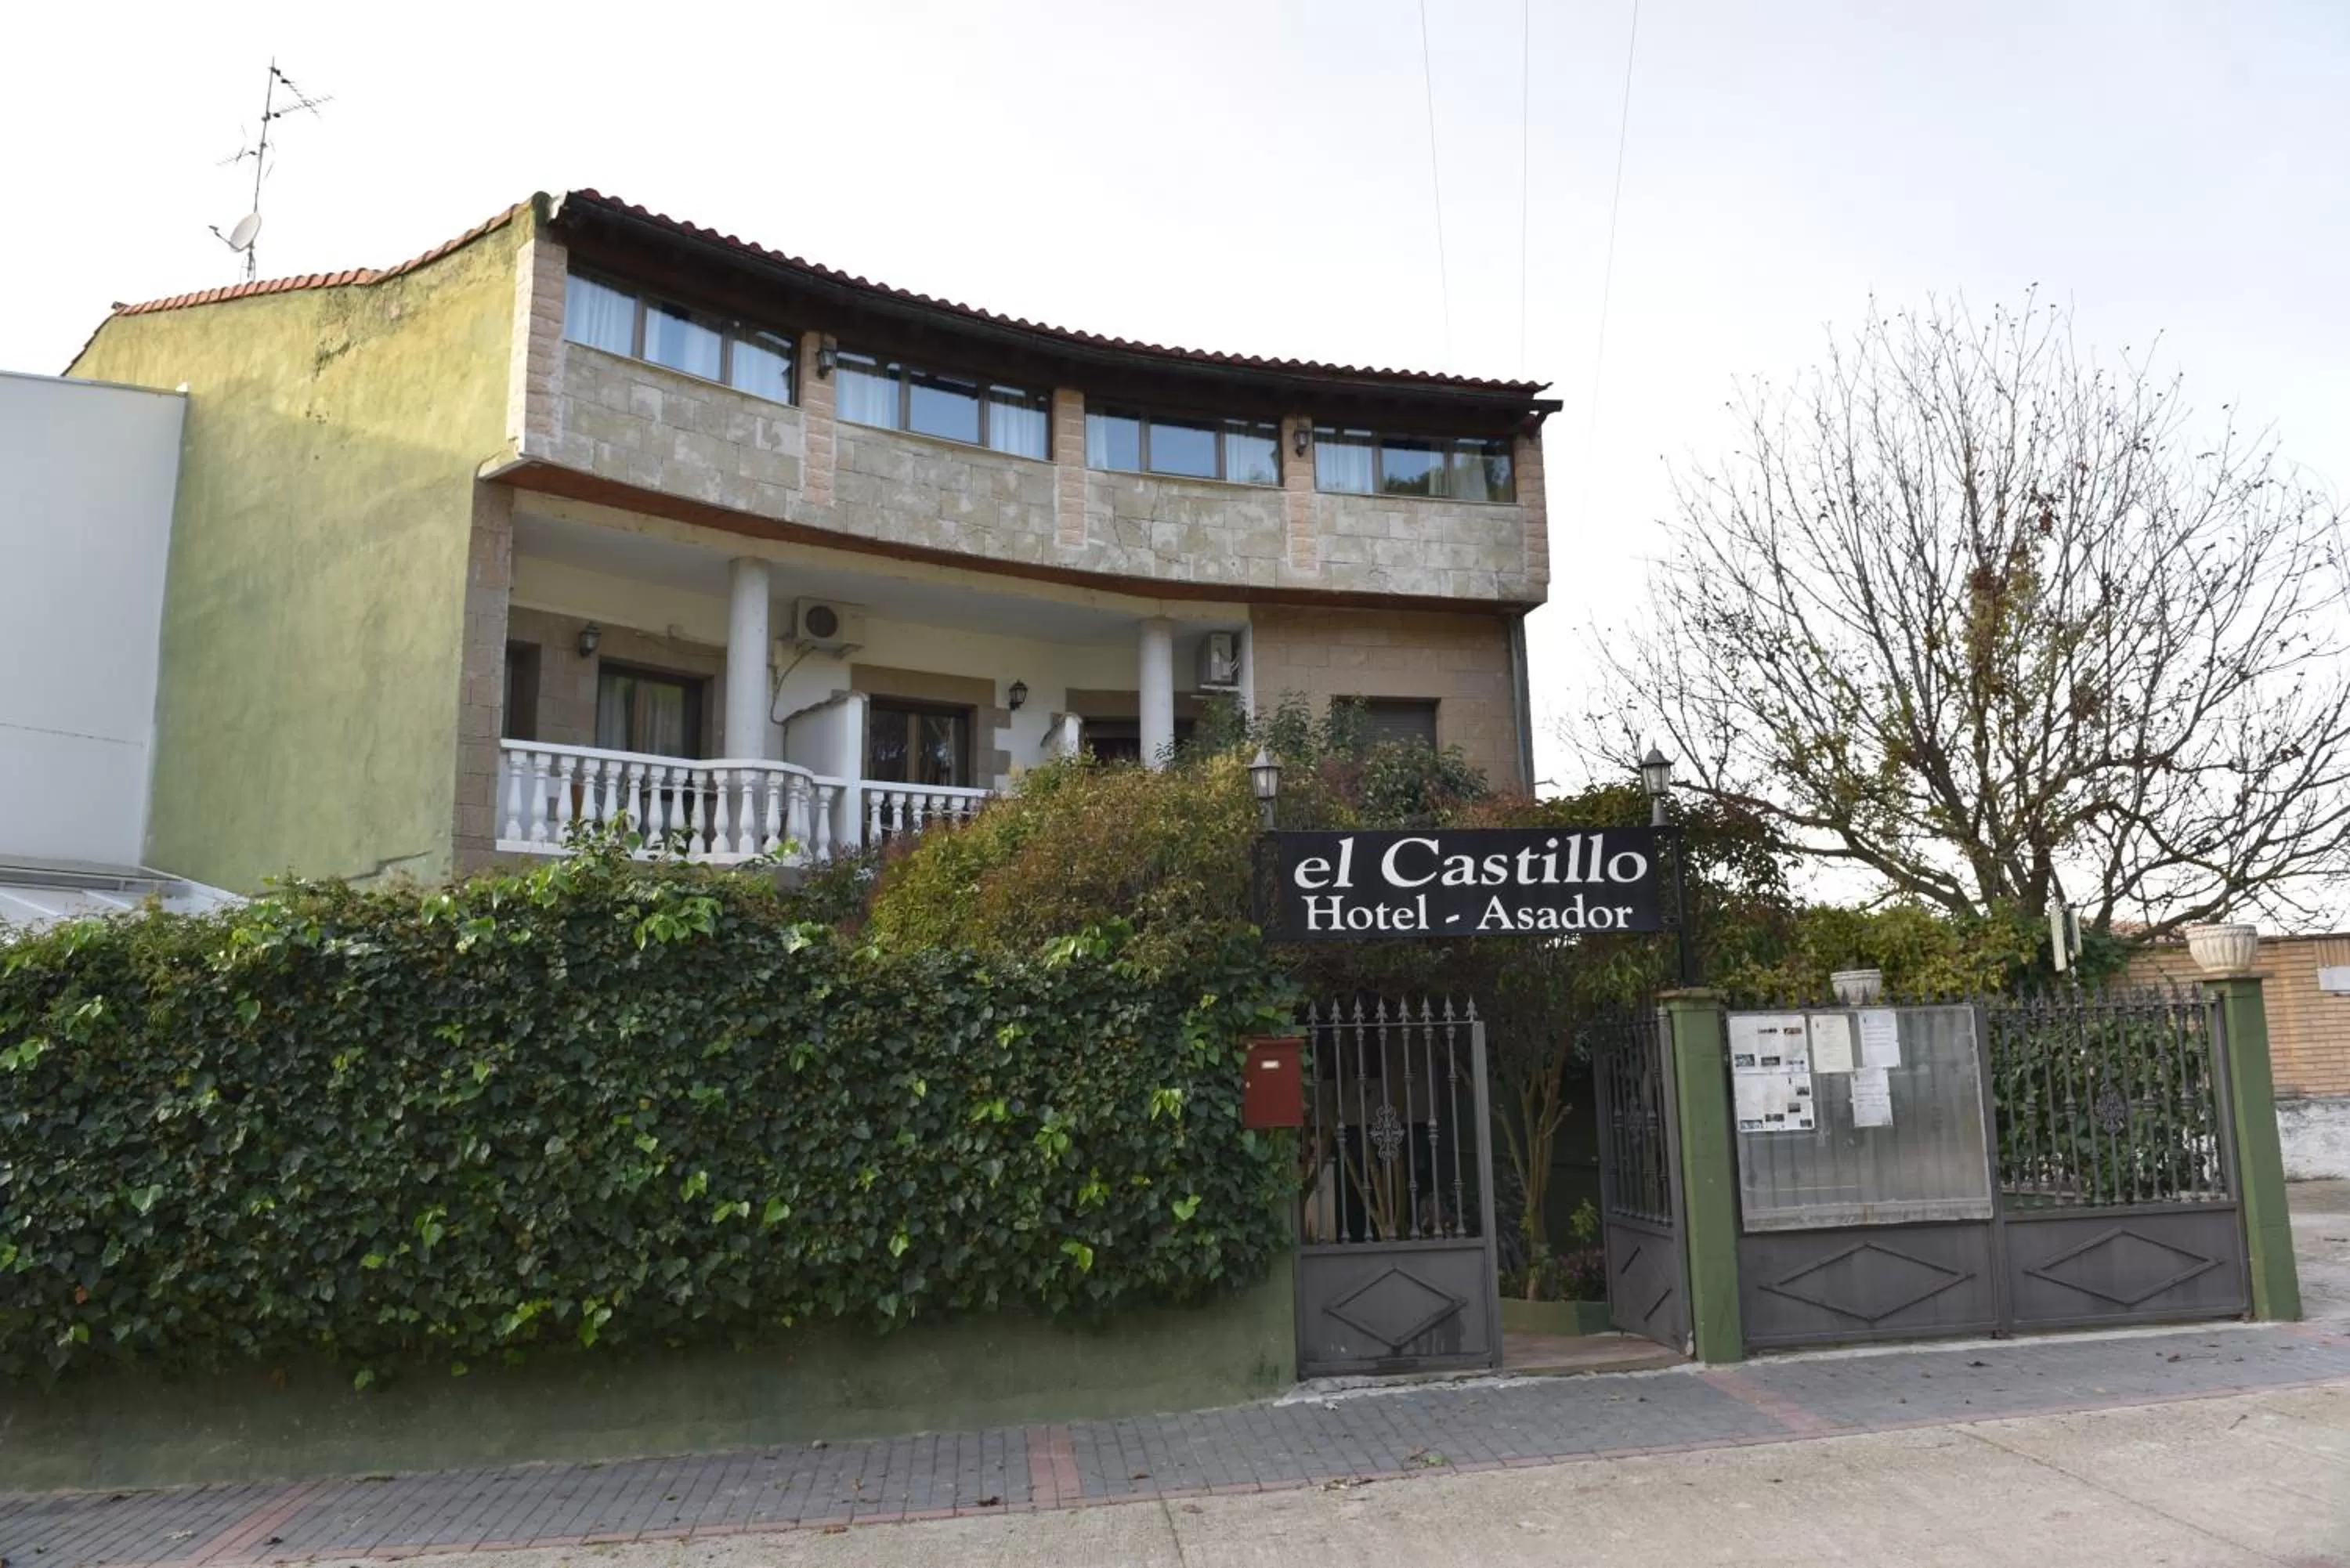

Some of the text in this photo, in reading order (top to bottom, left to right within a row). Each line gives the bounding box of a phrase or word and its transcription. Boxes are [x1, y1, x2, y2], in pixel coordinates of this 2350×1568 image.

[1293, 833, 1647, 889] el Castillo
[1301, 894, 1430, 930] Hotel
[1476, 893, 1633, 930] Asador
